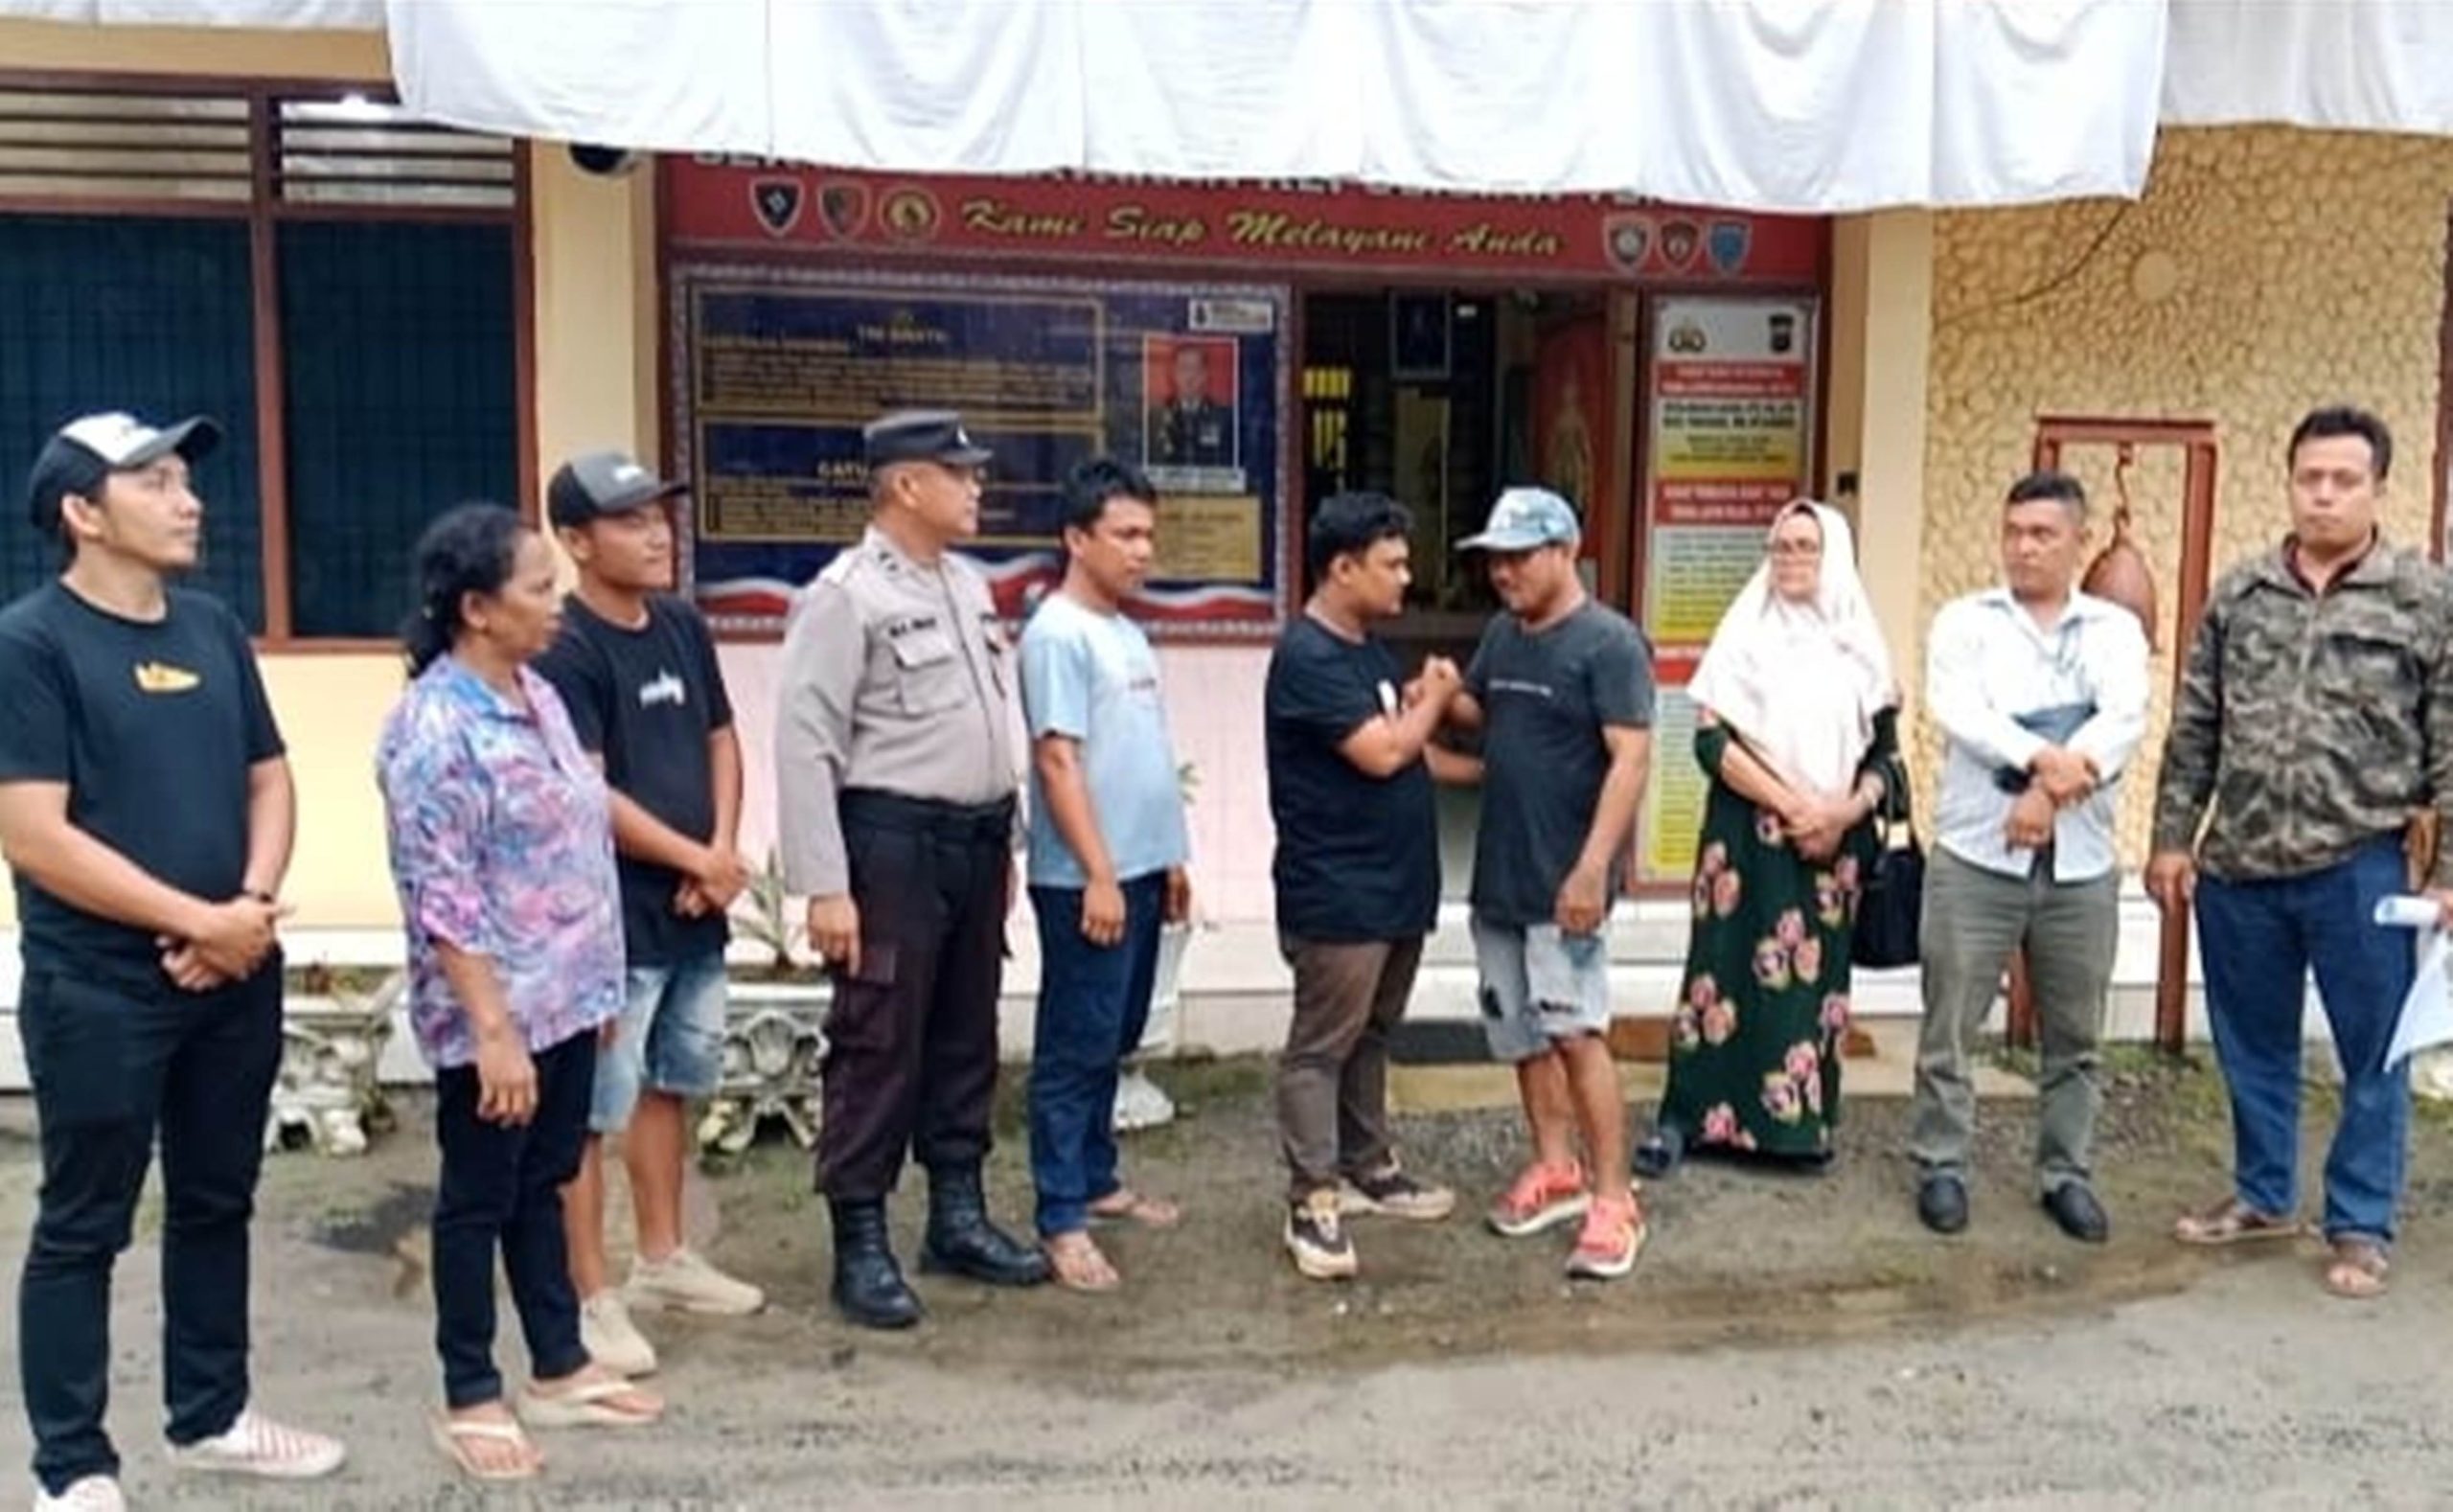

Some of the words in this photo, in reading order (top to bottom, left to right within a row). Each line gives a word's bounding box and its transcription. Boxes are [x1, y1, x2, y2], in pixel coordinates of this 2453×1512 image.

[961, 199, 1084, 236] Kami
[1105, 205, 1205, 244] Siap
[1226, 210, 1428, 254] Melayani
[1448, 222, 1560, 255] Anda
